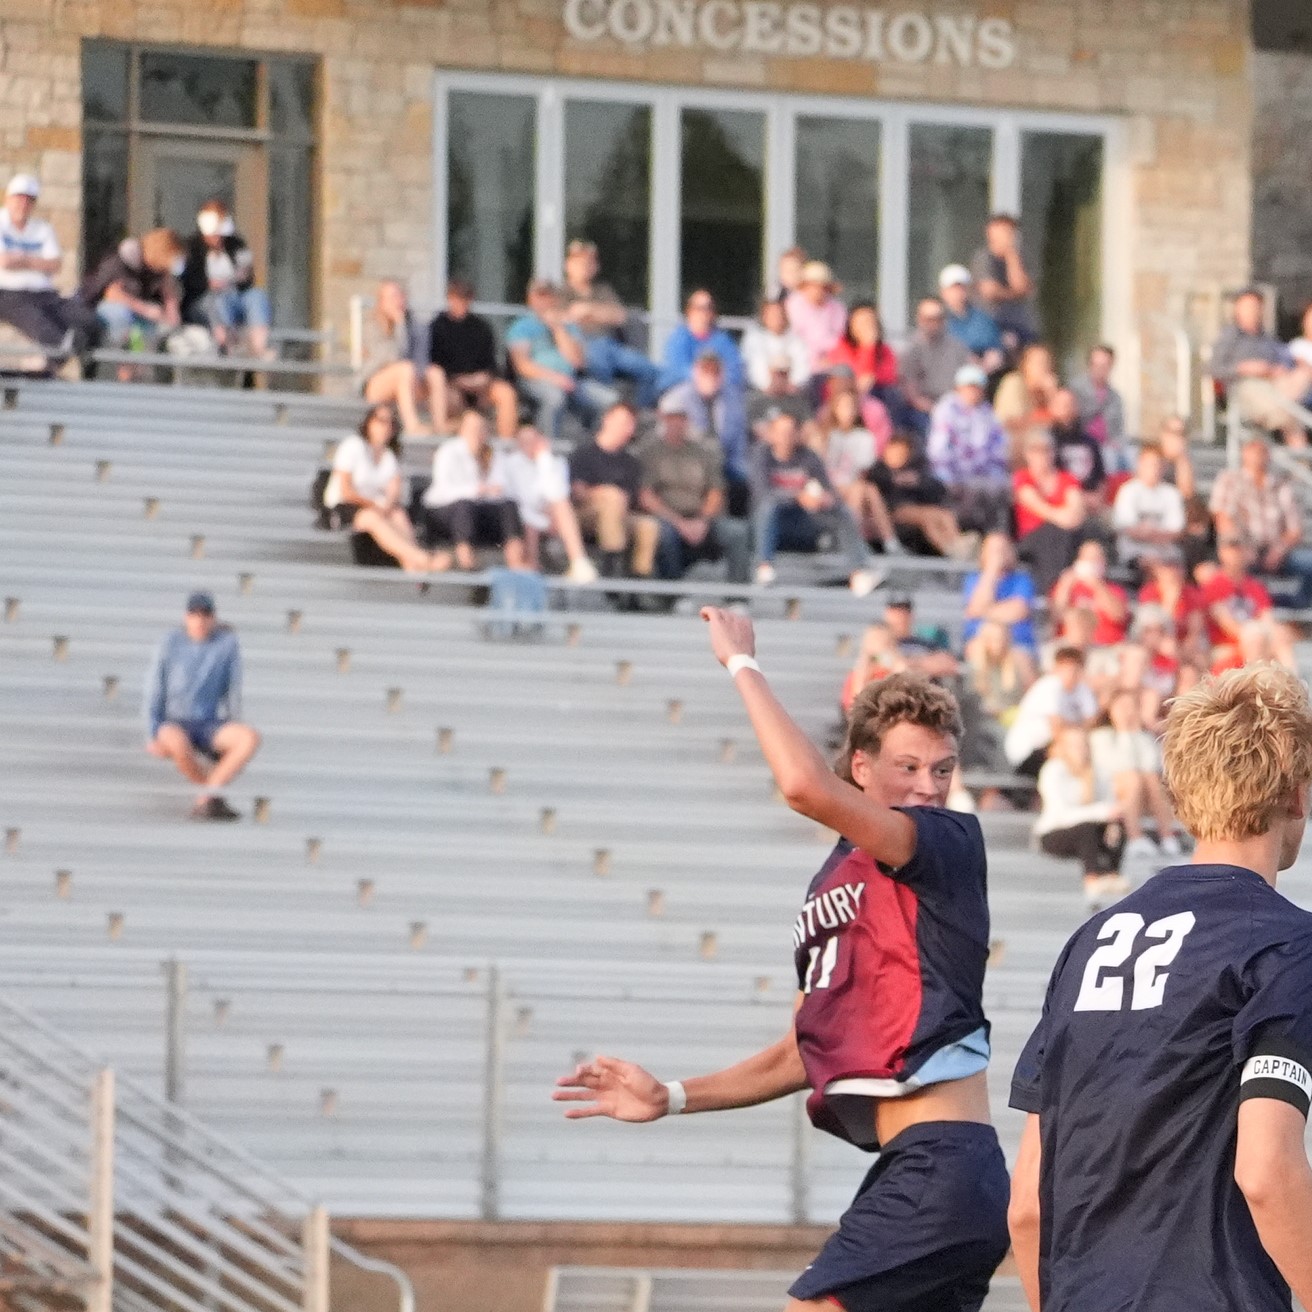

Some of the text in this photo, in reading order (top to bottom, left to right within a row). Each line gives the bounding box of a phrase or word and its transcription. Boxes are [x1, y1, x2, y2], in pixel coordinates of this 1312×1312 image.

[562, 0, 1015, 68] CONCESSIONS
[804, 935, 838, 994] 11
[1073, 910, 1196, 1012] 22
[1254, 1059, 1308, 1087] CAPTAIN
